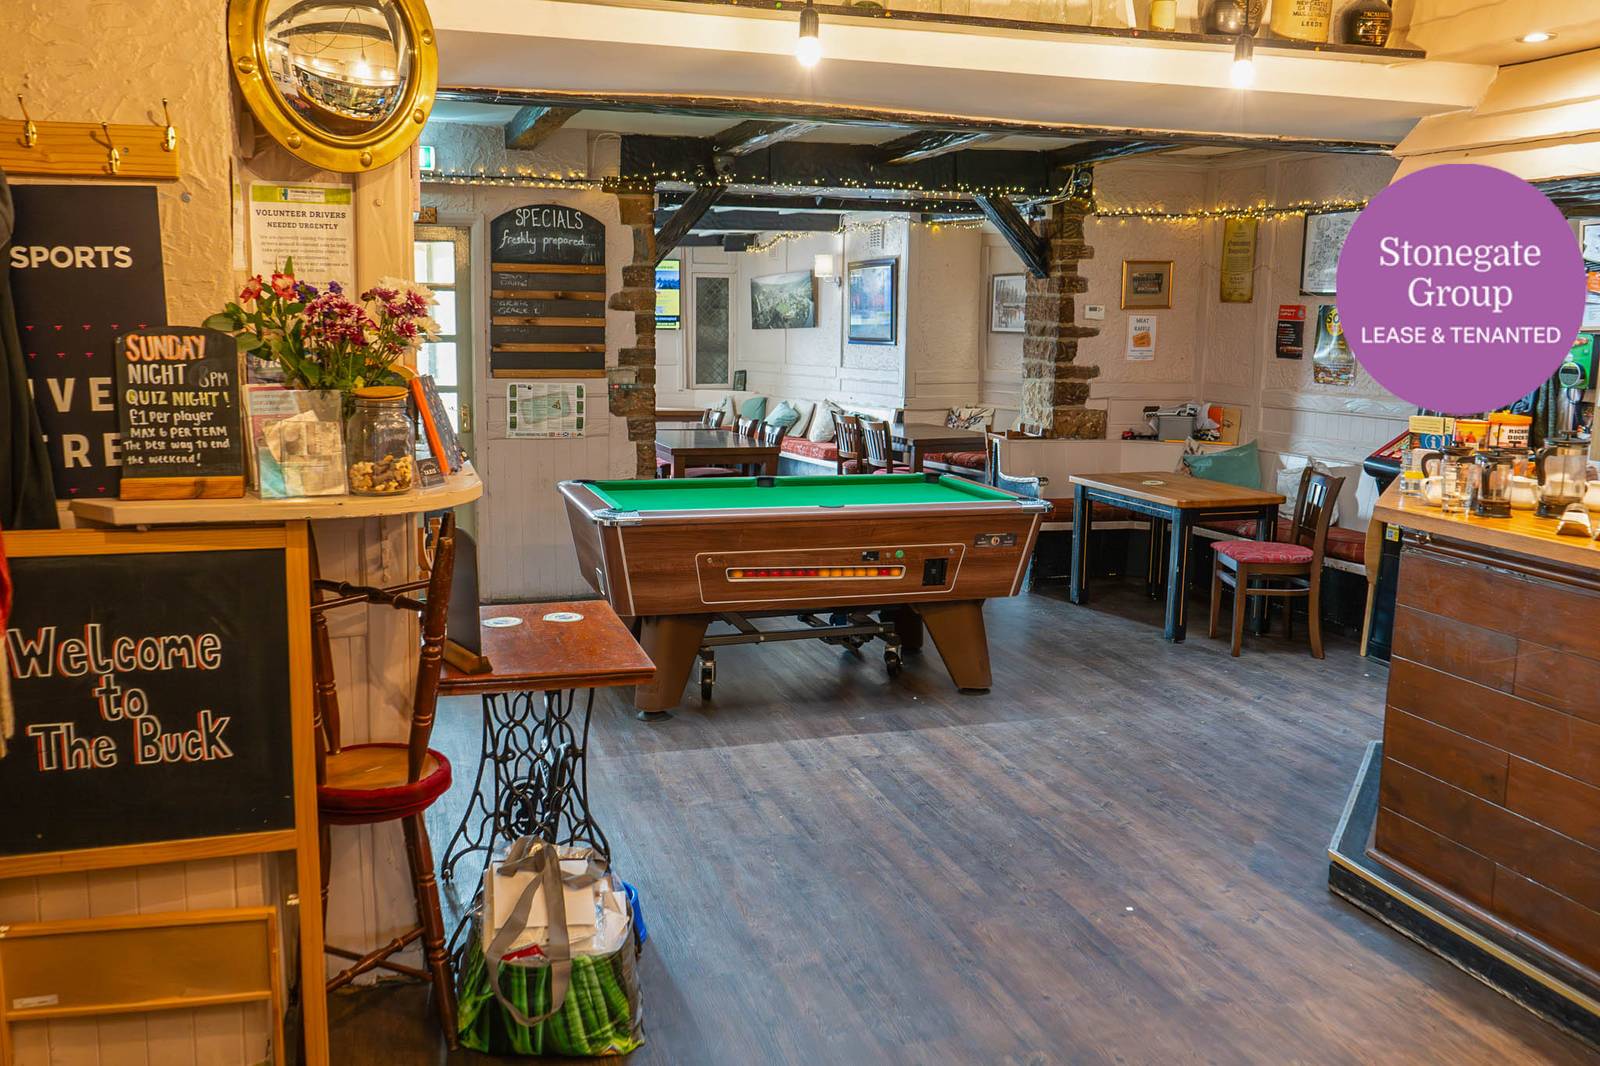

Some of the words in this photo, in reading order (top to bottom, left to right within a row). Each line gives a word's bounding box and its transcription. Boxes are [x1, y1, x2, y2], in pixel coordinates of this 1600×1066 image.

[255, 209, 307, 218] VOLUNTEER
[309, 211, 347, 219] DRIVERS
[515, 208, 584, 230] SPECIALS
[267, 221, 297, 229] NEEDED
[299, 222, 339, 230] URGENTLY
[499, 229, 537, 255] freshly
[9, 245, 134, 269] SPORTS
[125, 334, 206, 361] SUNDAY
[127, 363, 187, 385] NIGHT
[126, 389, 168, 406] QUIZ
[129, 408, 149, 425] £1
[173, 410, 214, 426] player
[130, 427, 156, 439] MAX
[159, 428, 168, 437] 6
[170, 427, 192, 438] PER
[192, 426, 228, 437] TEAM
[123, 440, 141, 450] The
[171, 442, 193, 452] way
[195, 440, 208, 448] to
[211, 438, 231, 448] end
[127, 454, 144, 465] the
[6, 623, 222, 679] Welcome
[92, 673, 149, 722] to
[26, 721, 118, 772] The
[134, 709, 234, 765] Buck
